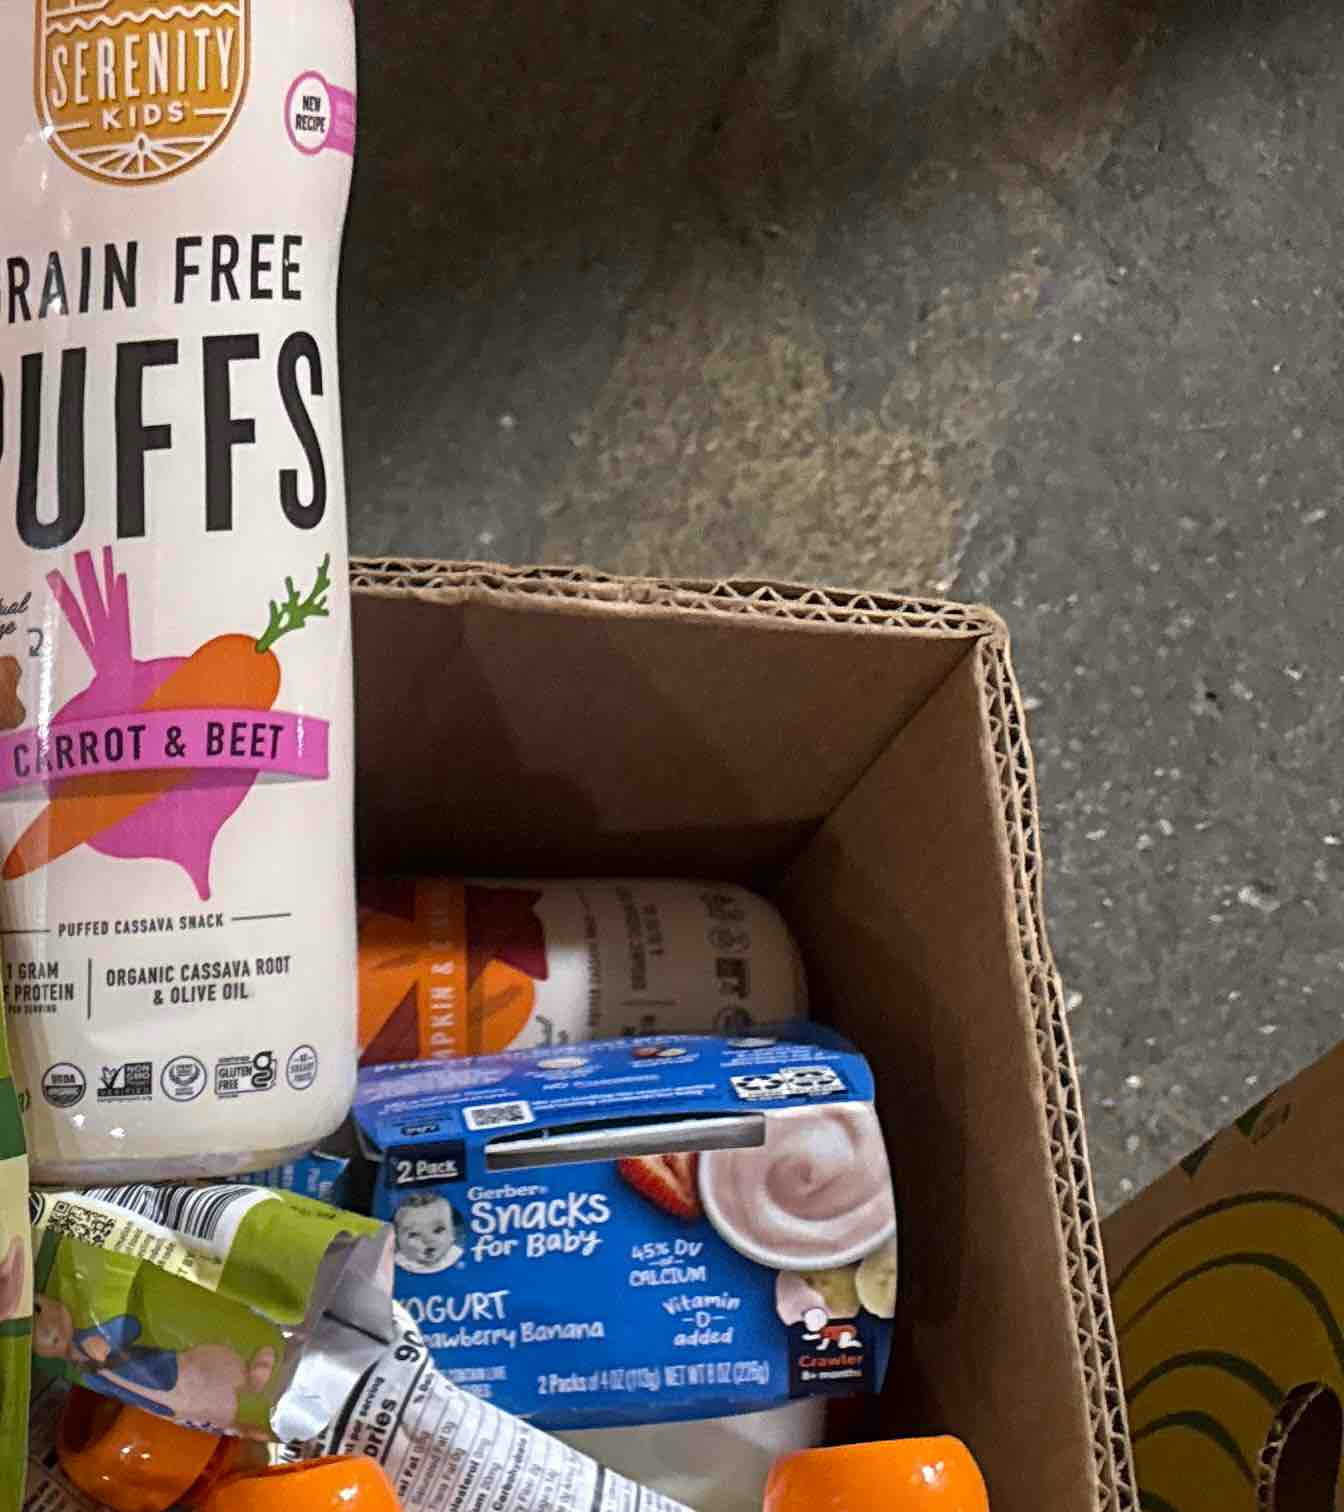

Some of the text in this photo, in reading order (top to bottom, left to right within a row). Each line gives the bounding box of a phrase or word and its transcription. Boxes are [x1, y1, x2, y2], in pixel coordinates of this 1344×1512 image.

[50, 25, 237, 109] SERENITY
[302, 95, 322, 112] NEW
[101, 103, 187, 130] KIDS
[295, 114, 325, 134] RECIPE
[174, 234, 304, 305] FREE
[14, 722, 284, 777] CARROT BEET
[59, 913, 224, 938] PUFFED CASSAVA SNACK
[18, 962, 59, 978] GRAM
[106, 955, 291, 986] ORGANIC CASSAVA ROOT
[14, 984, 74, 1001] PROTEIN
[170, 982, 249, 1004] OLIVE OIL
[219, 1065, 251, 1078] GLUTEN
[415, 1160, 457, 1180] Pack
[470, 1192, 610, 1234] Snacks
[471, 1230, 602, 1264] for Baby
[630, 1266, 705, 1287] CALCIUM
[663, 1292, 740, 1314] Vitamin
[521, 1321, 605, 1342] Banana
[674, 1327, 733, 1347] added
